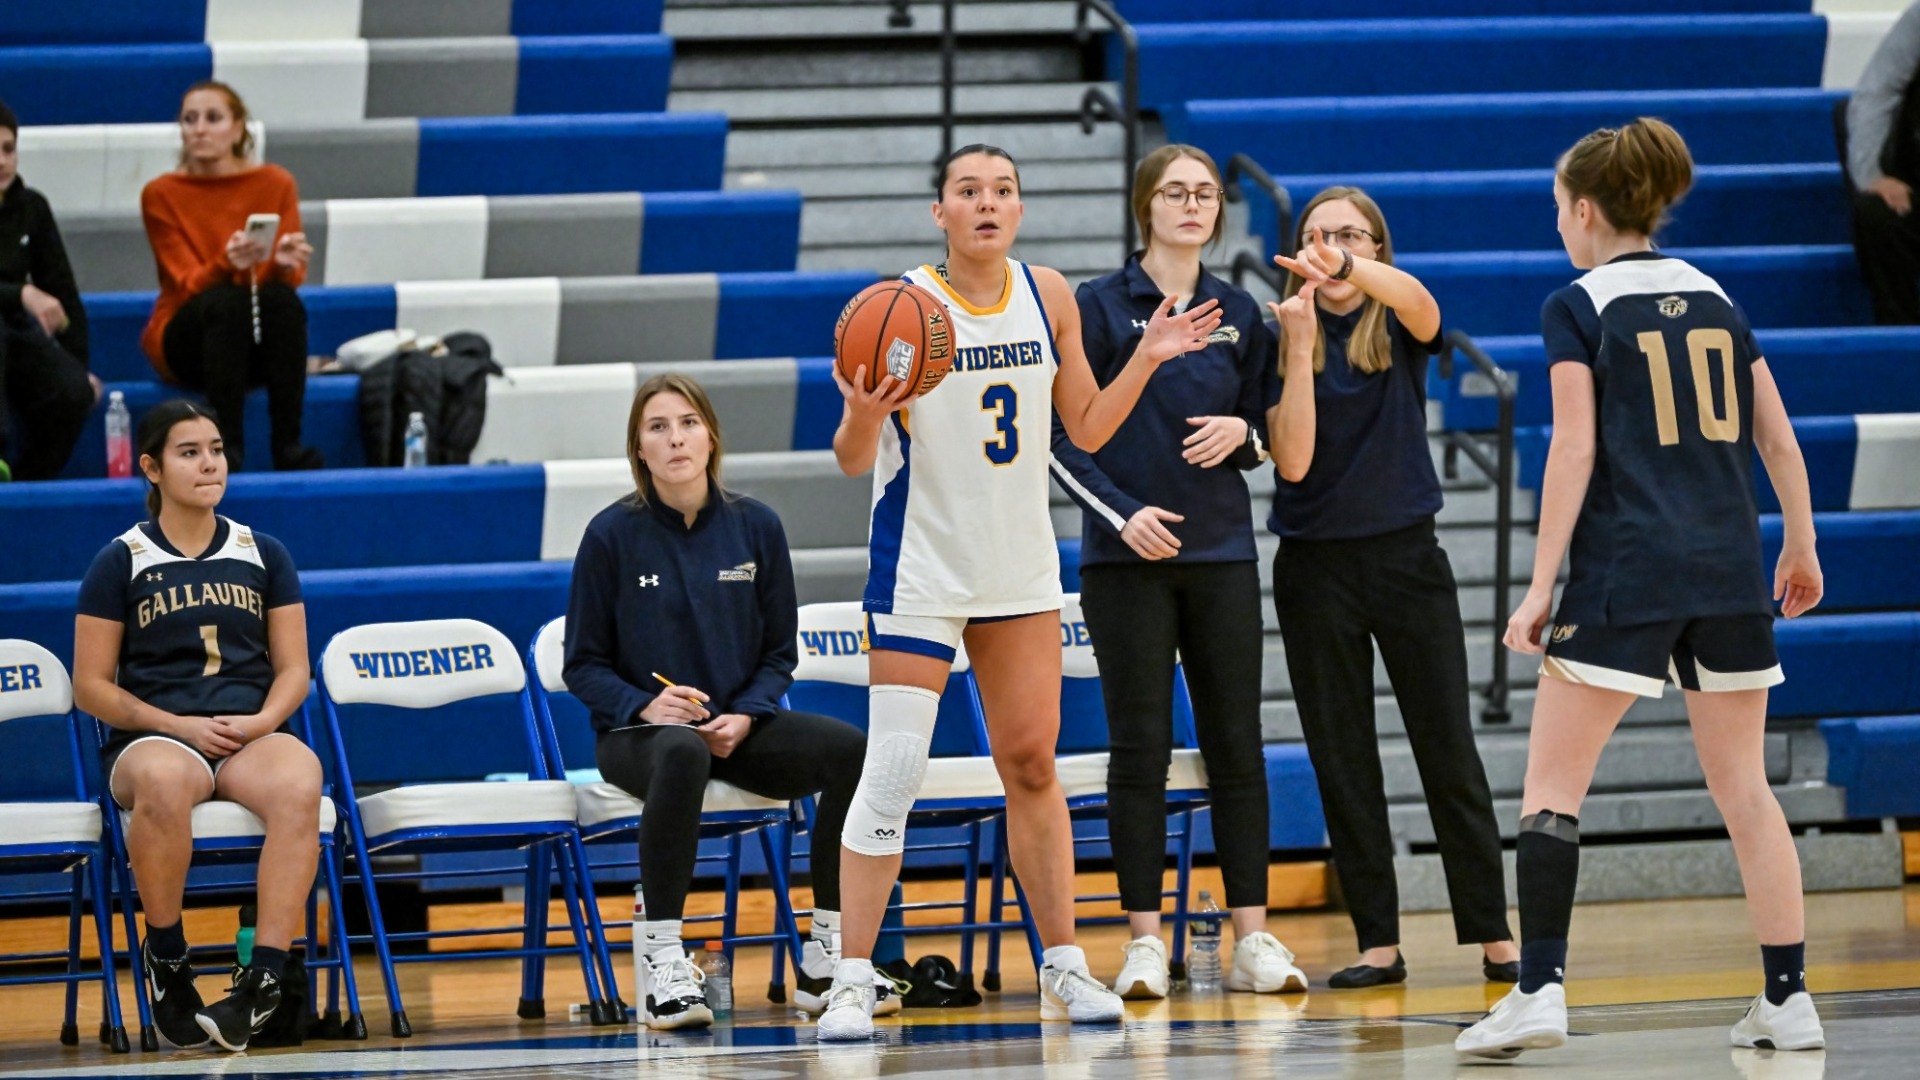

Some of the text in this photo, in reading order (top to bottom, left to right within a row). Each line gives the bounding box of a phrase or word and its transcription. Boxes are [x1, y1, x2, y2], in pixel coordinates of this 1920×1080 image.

[897, 344, 912, 380] MAC
[1636, 329, 1740, 446] 10
[981, 381, 1020, 467] 3
[199, 625, 222, 677] 1
[350, 643, 495, 678] WIDENER
